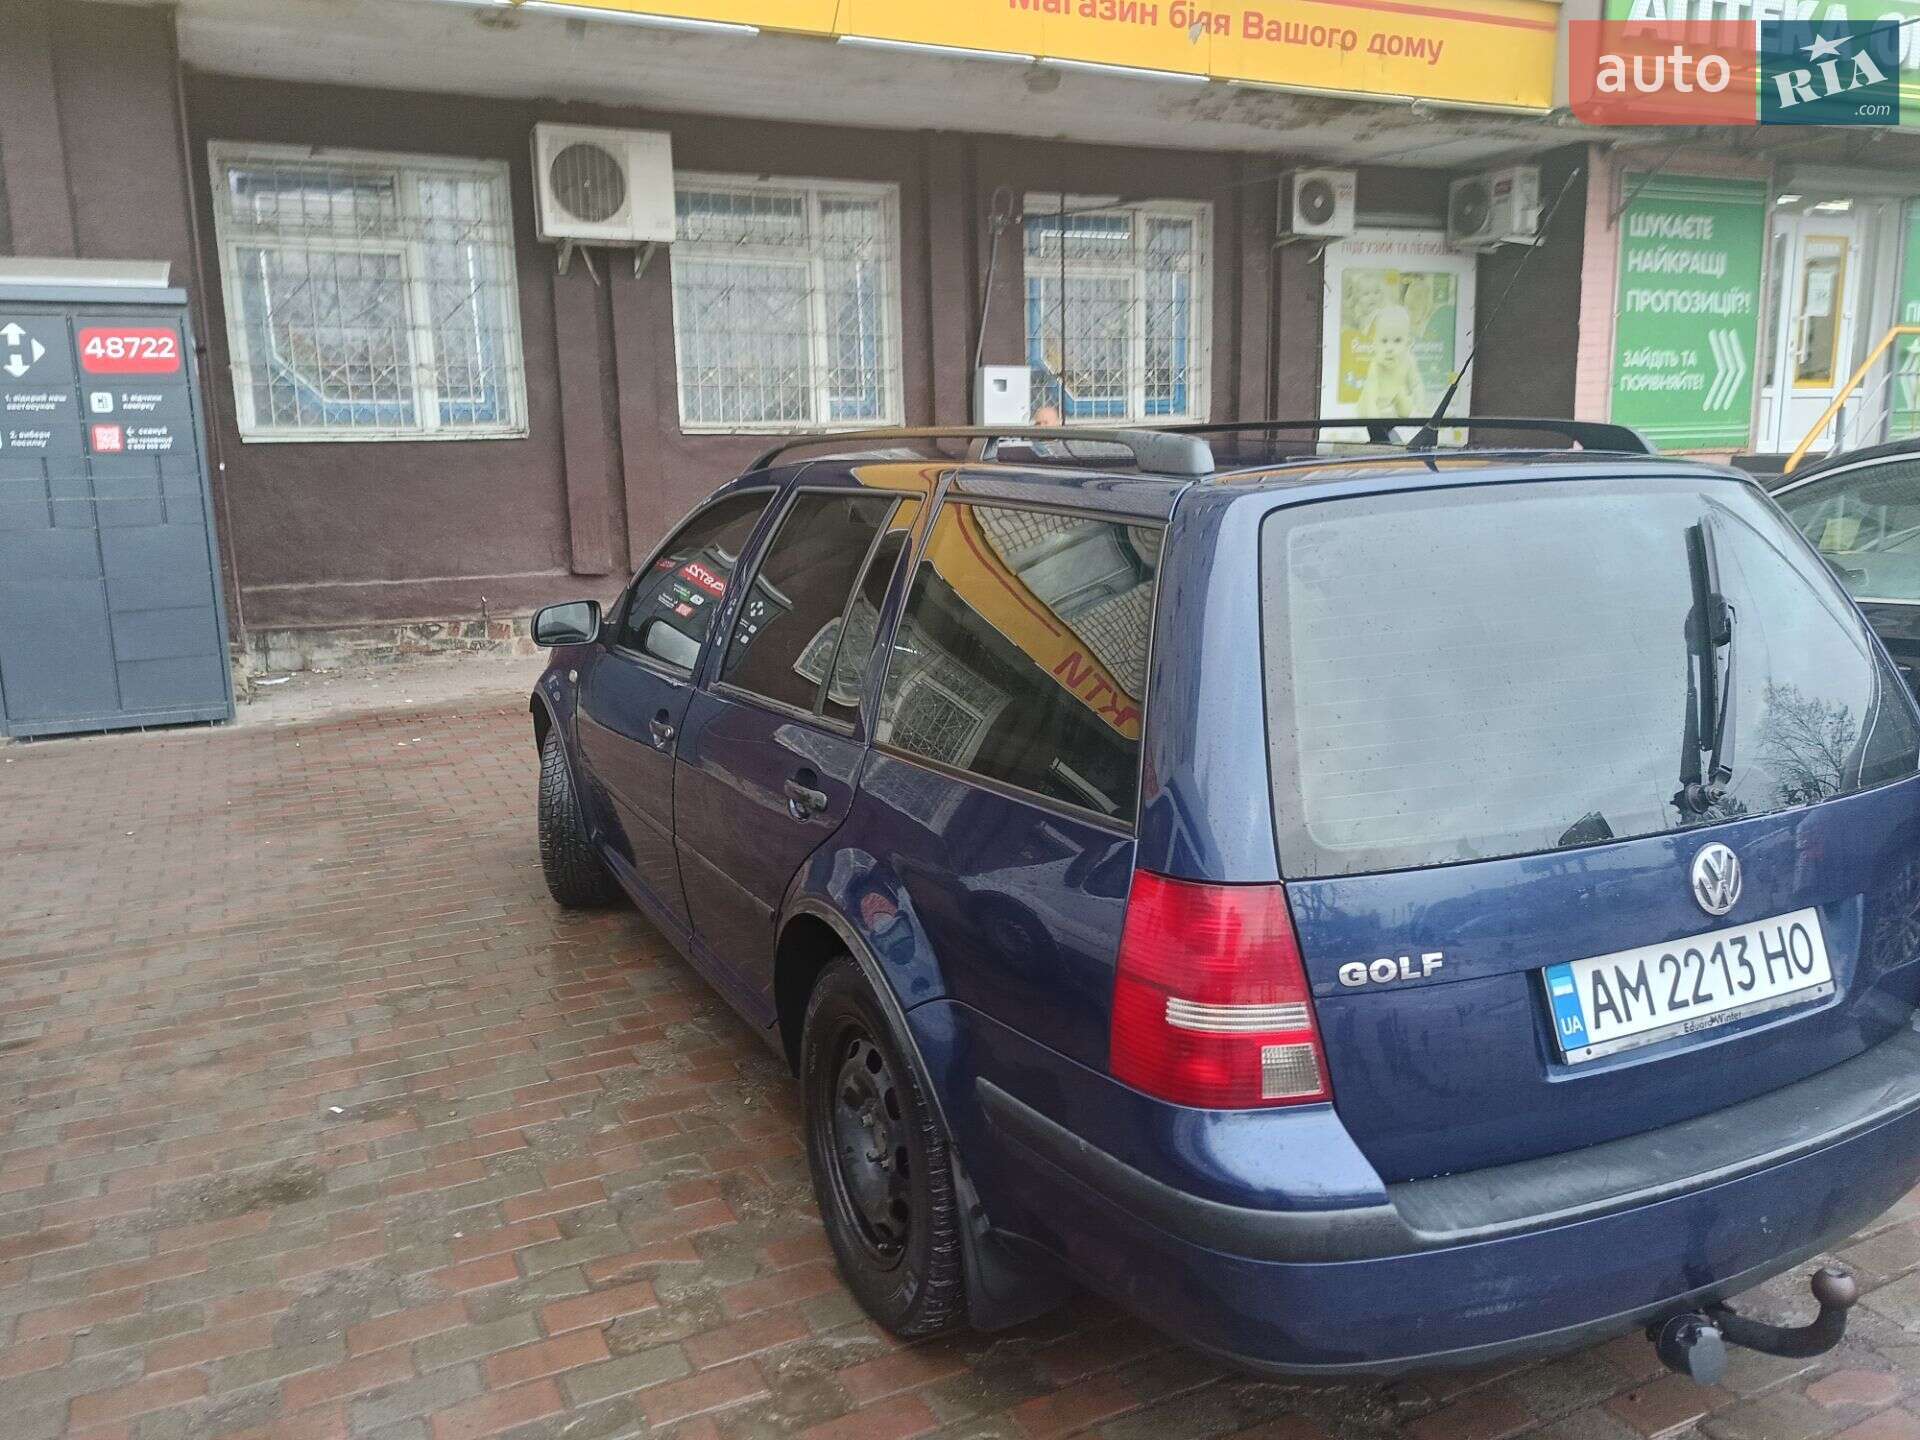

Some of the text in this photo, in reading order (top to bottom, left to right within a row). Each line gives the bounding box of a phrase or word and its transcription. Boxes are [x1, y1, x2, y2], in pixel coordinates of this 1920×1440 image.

[1242, 11, 1358, 51] Вашого
[1366, 33, 1444, 66] дому
[1629, 212, 1714, 240] ШУКАЄТЕ
[1627, 244, 1728, 279] НАЙКРАЩІ
[84, 336, 176, 360] 48722
[1680, 350, 1698, 368] ТА
[1338, 952, 1444, 988] GOLF
[1591, 922, 1815, 1031] AM 2213 HO
[1560, 1014, 1584, 1035] UA
